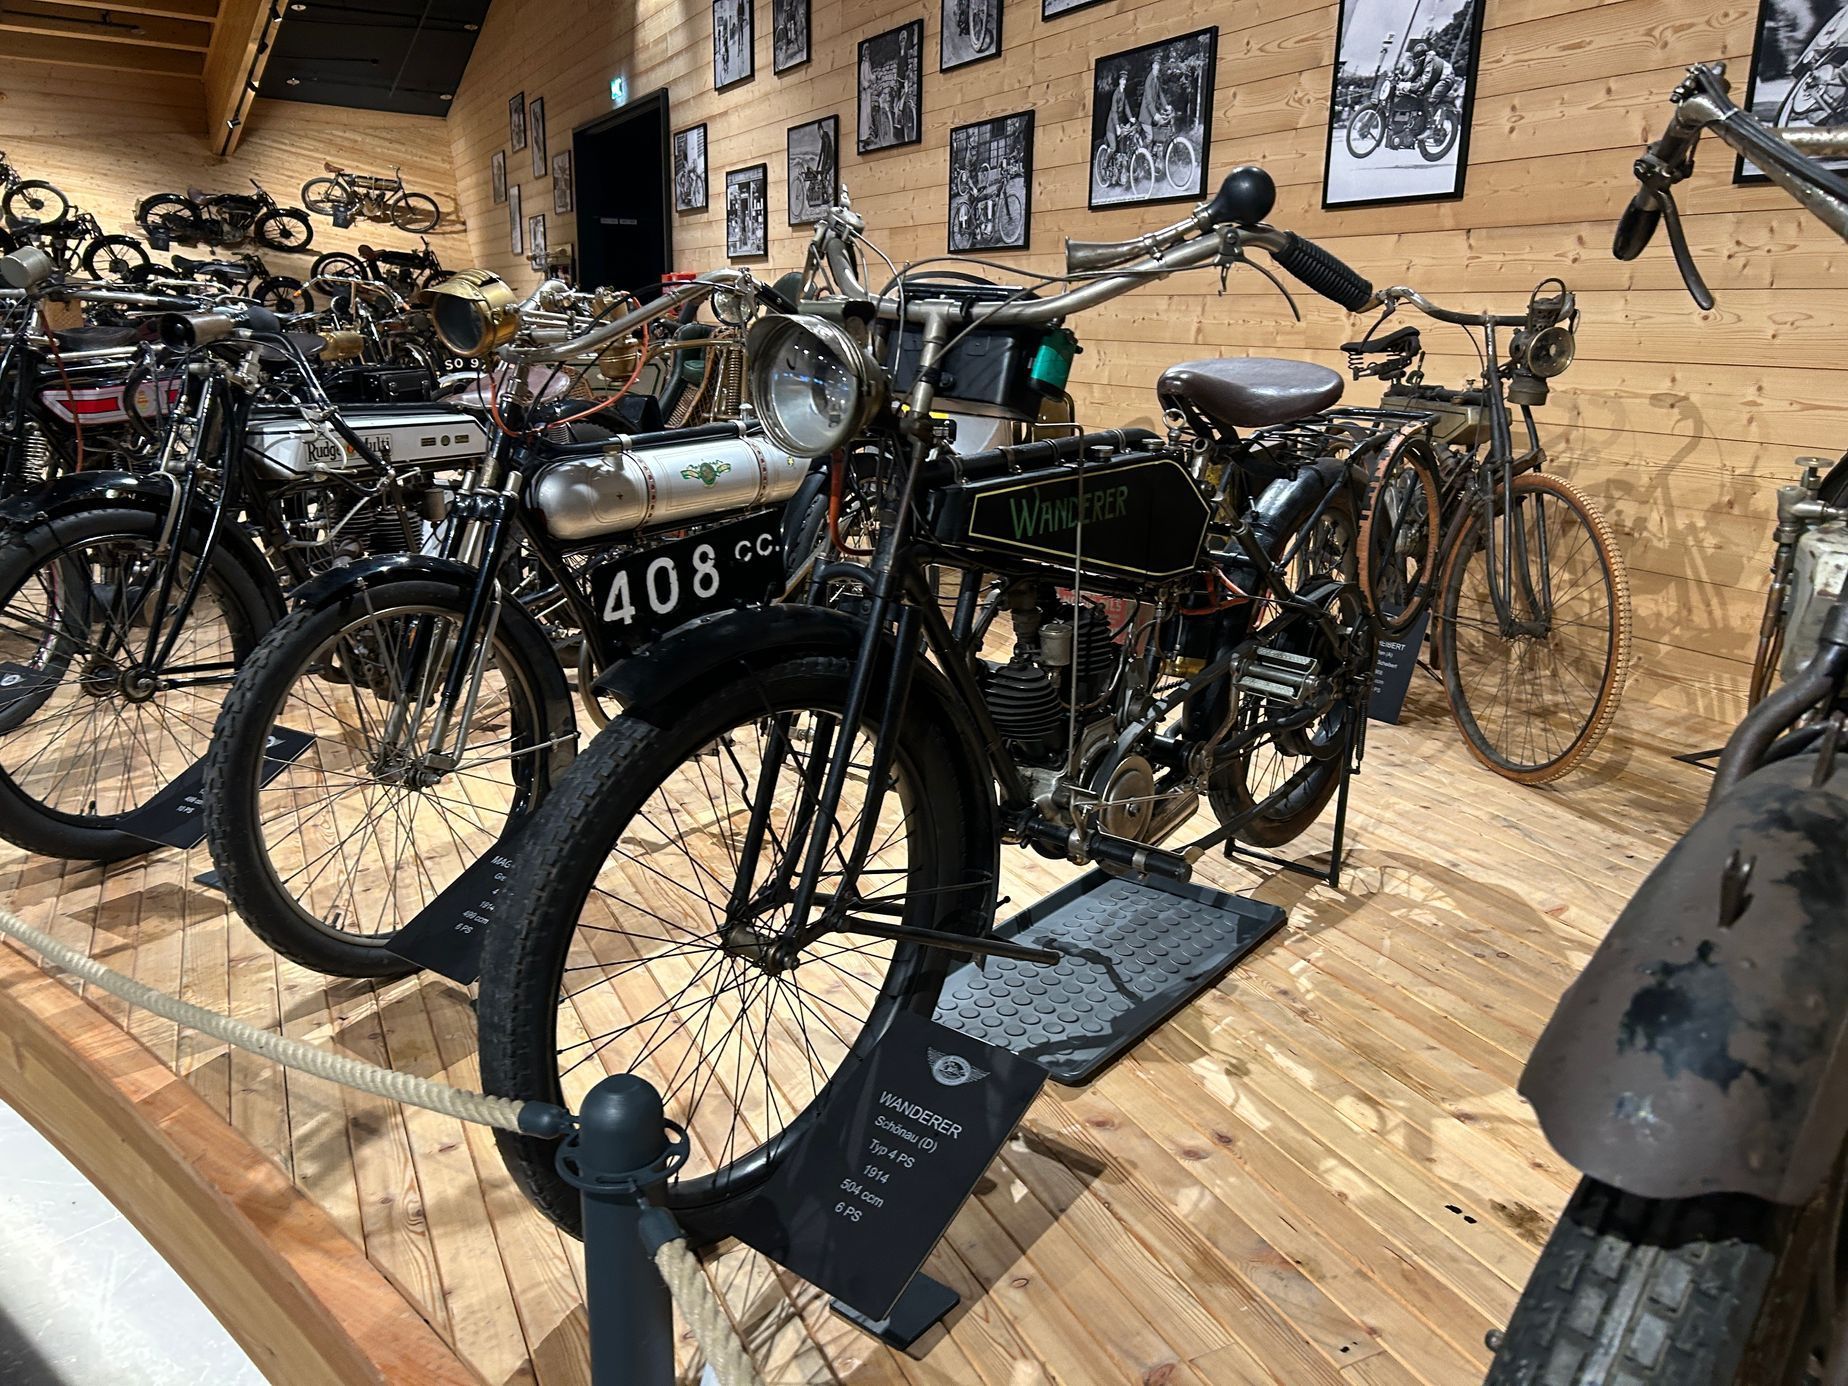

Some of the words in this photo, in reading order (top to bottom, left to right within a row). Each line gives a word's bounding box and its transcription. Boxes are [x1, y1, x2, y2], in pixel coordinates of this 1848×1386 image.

[444, 358, 464, 370] SO
[603, 544, 720, 625] 408
[460, 924, 473, 934] PS
[878, 1090, 963, 1139] WANDERER
[874, 1115, 919, 1144] Schönau
[918, 1138, 939, 1154] (D)
[868, 1138, 888, 1157] Typ
[887, 1149, 897, 1161] 4
[896, 1153, 916, 1169] PS
[863, 1164, 890, 1184] 1914
[839, 1178, 862, 1196] 504
[860, 1190, 885, 1208] ccm
[834, 1201, 844, 1214] 6
[843, 1205, 863, 1223] PS
